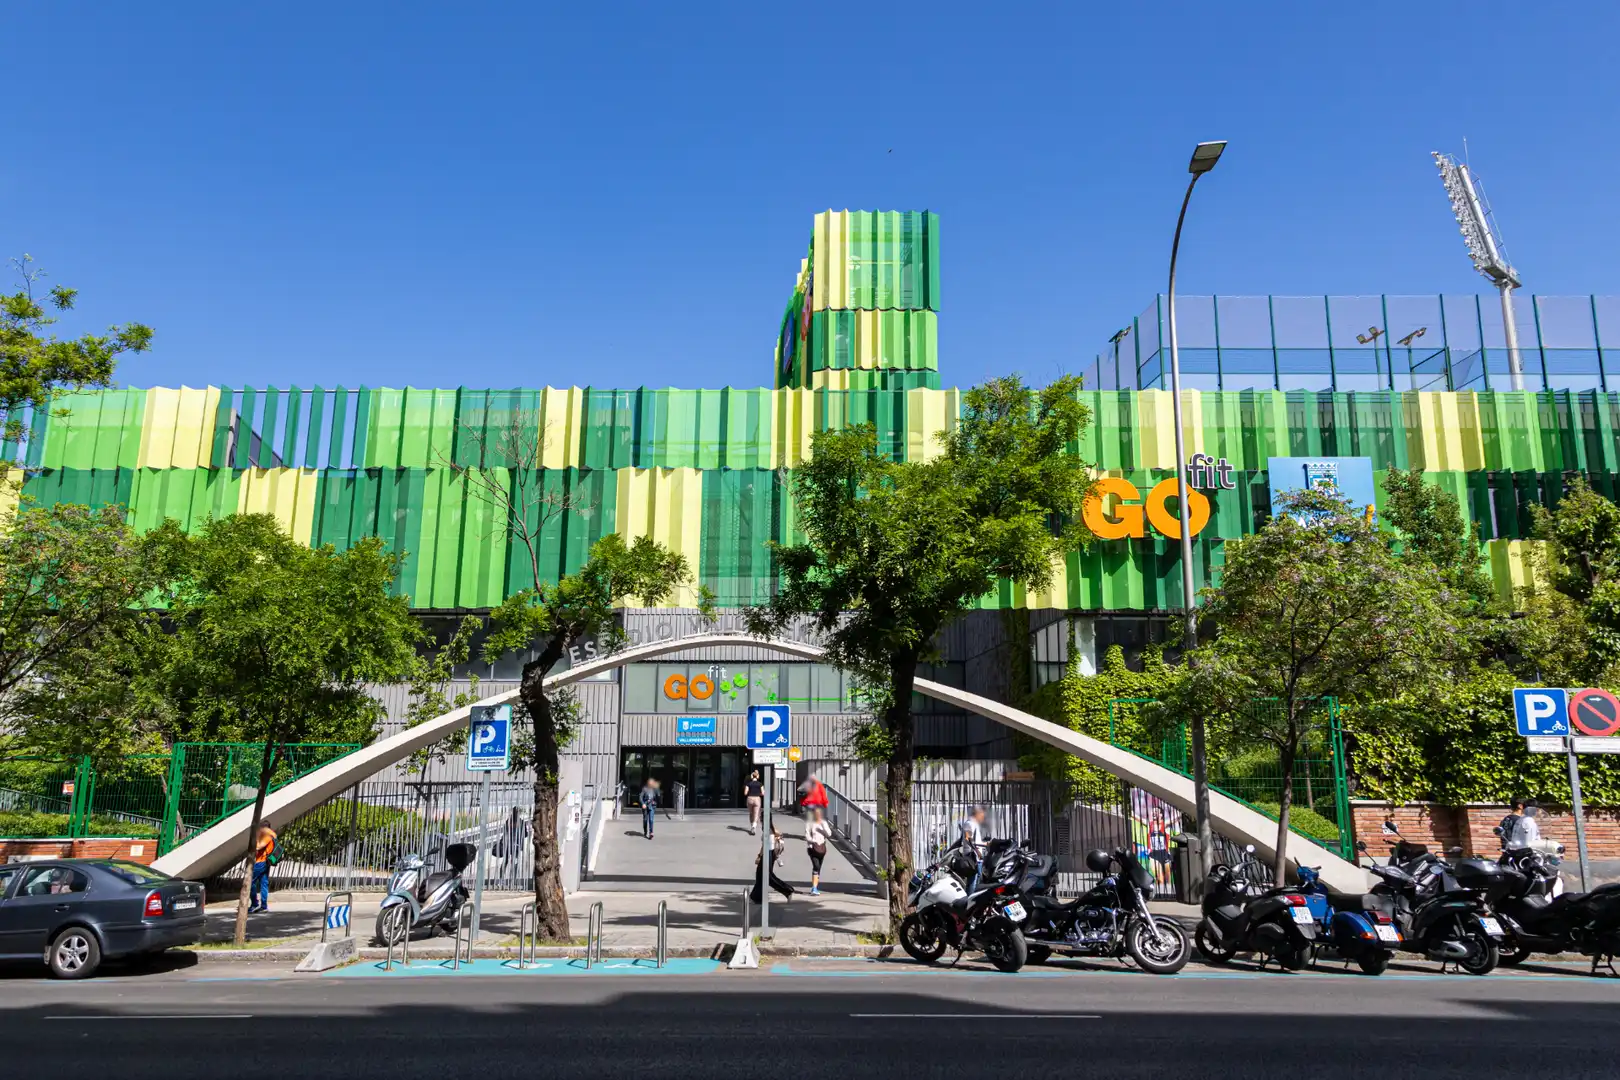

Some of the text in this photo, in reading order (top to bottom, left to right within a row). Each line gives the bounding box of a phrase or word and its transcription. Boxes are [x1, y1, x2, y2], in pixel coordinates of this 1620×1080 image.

[1082, 453, 1236, 540] GO fit
[664, 665, 727, 700] GO fit
[755, 710, 781, 744] P
[1524, 694, 1556, 731] P
[473, 724, 497, 753] P
